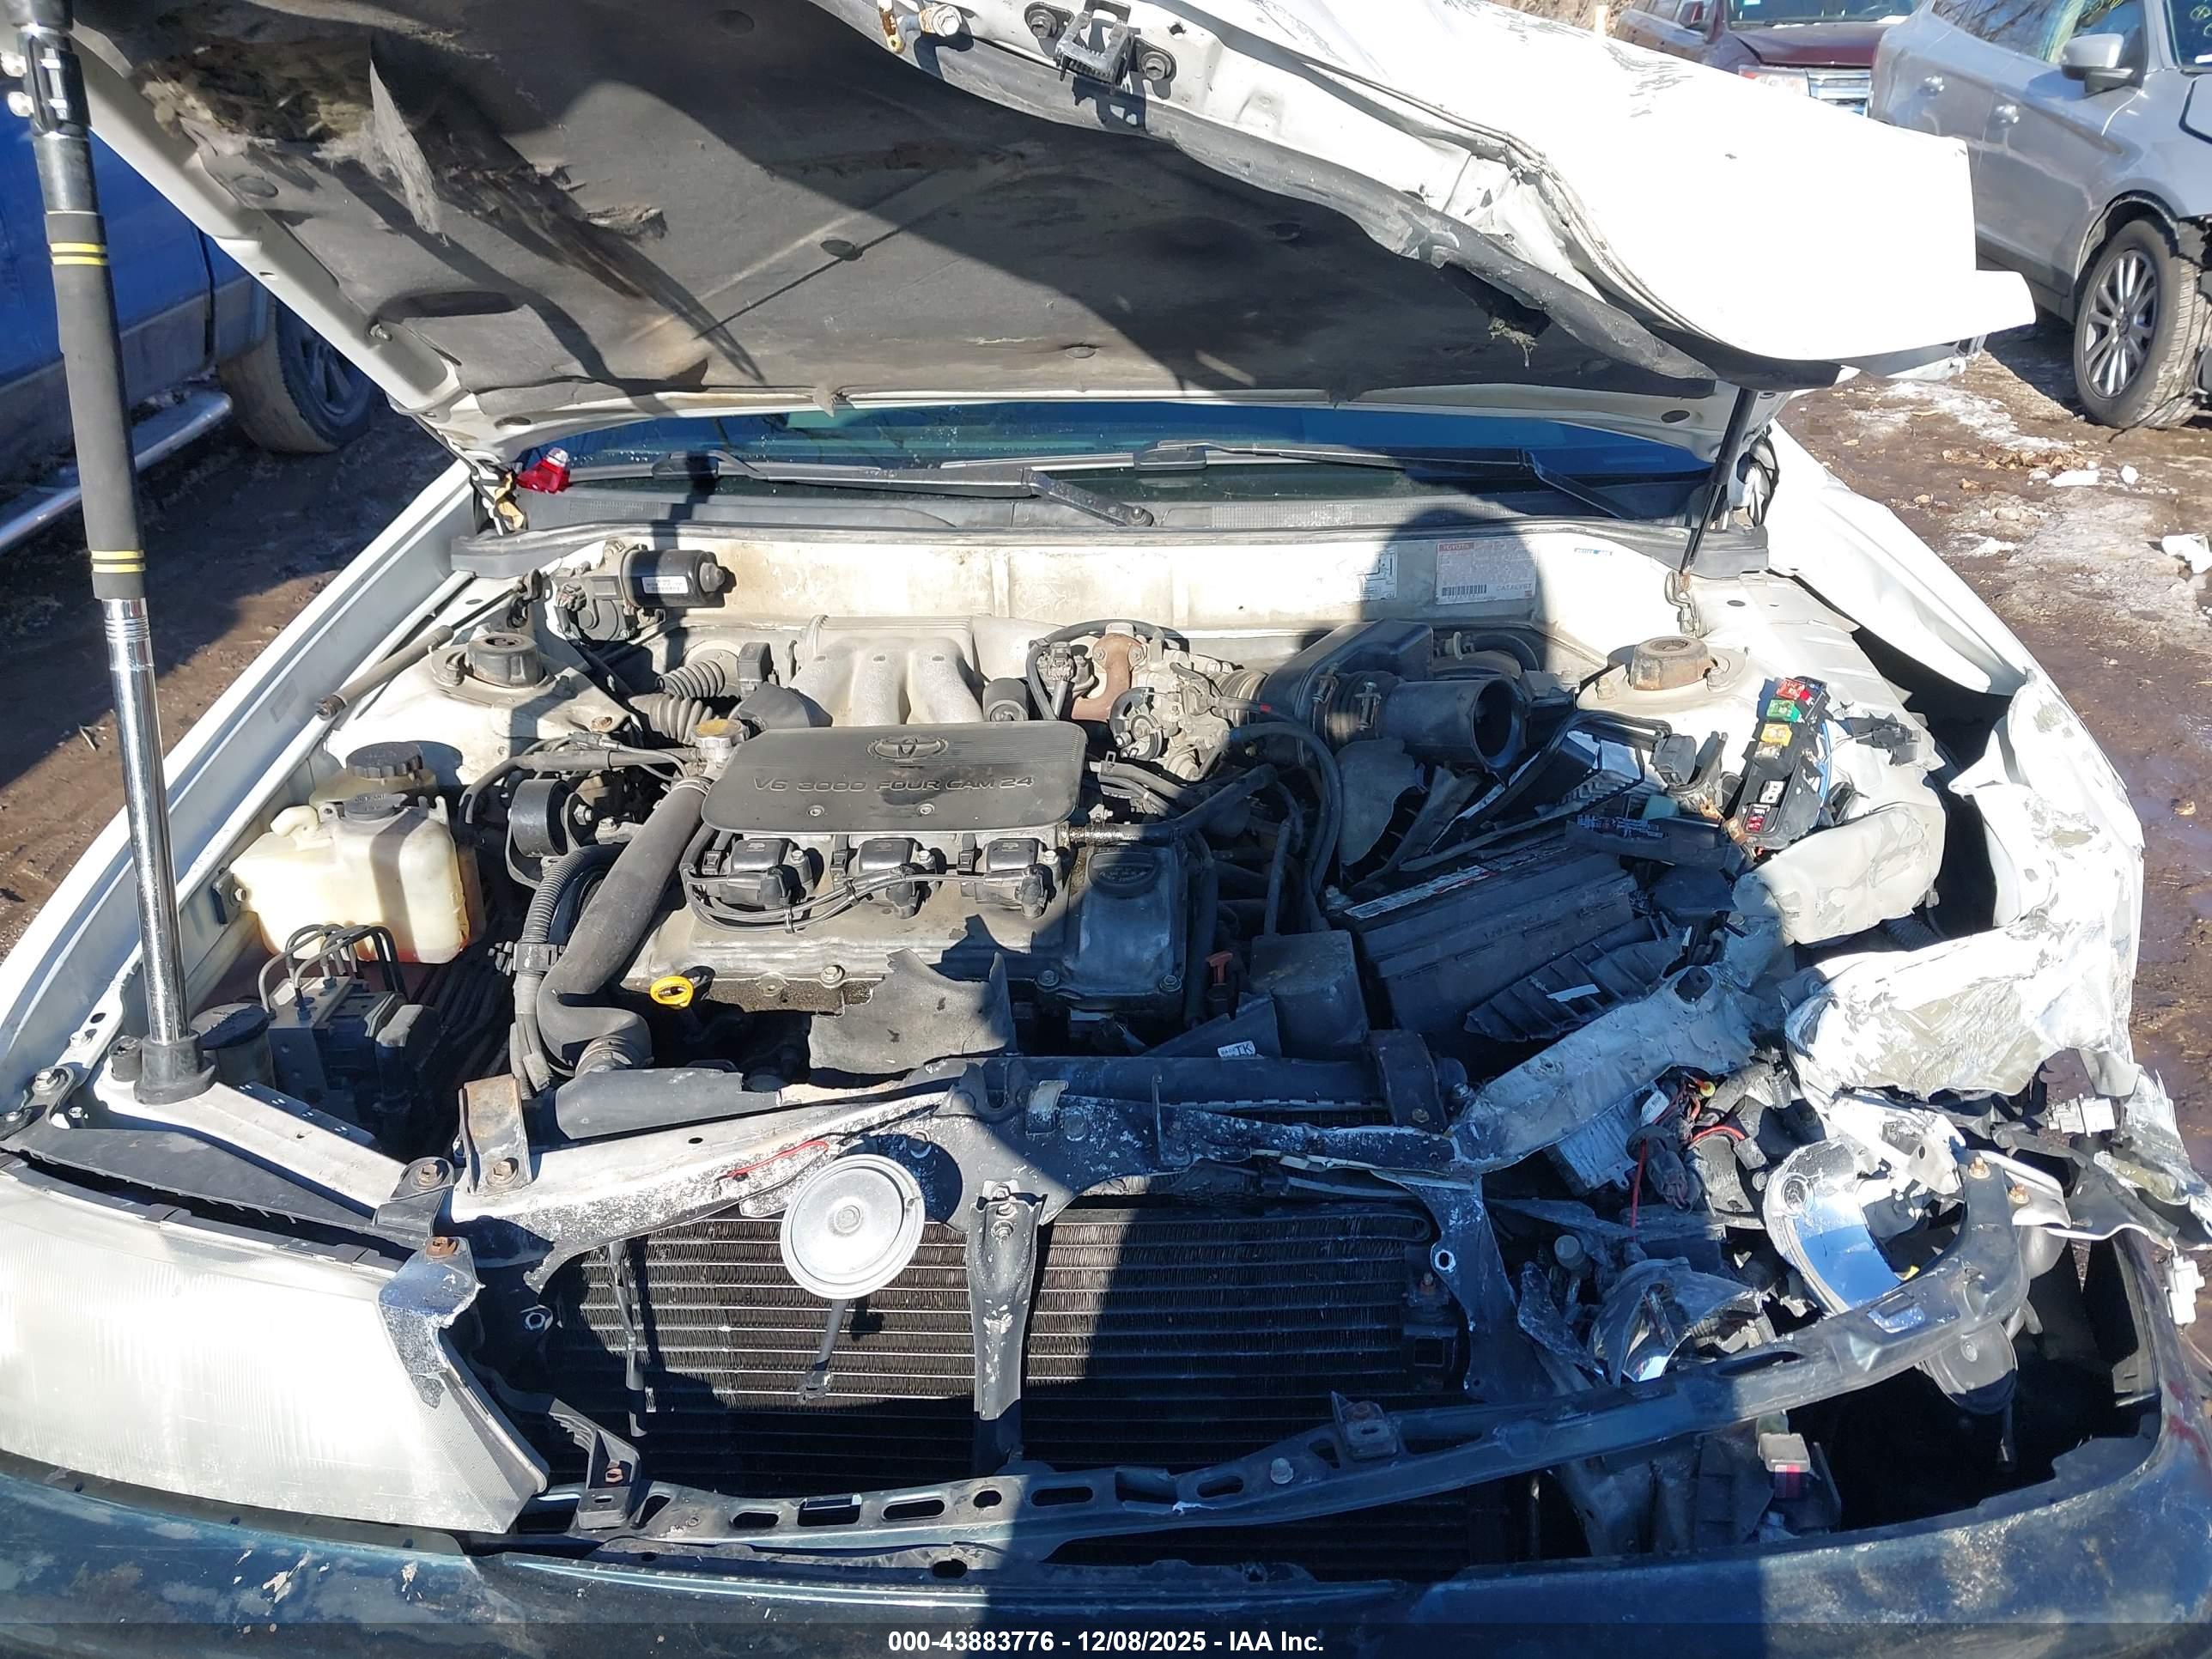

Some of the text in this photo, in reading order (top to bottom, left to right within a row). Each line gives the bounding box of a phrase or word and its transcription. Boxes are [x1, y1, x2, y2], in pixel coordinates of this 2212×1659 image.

[1496, 583, 1533, 592] CATALYST
[752, 775, 1035, 793] V6 3000 FOUR CAM 24
